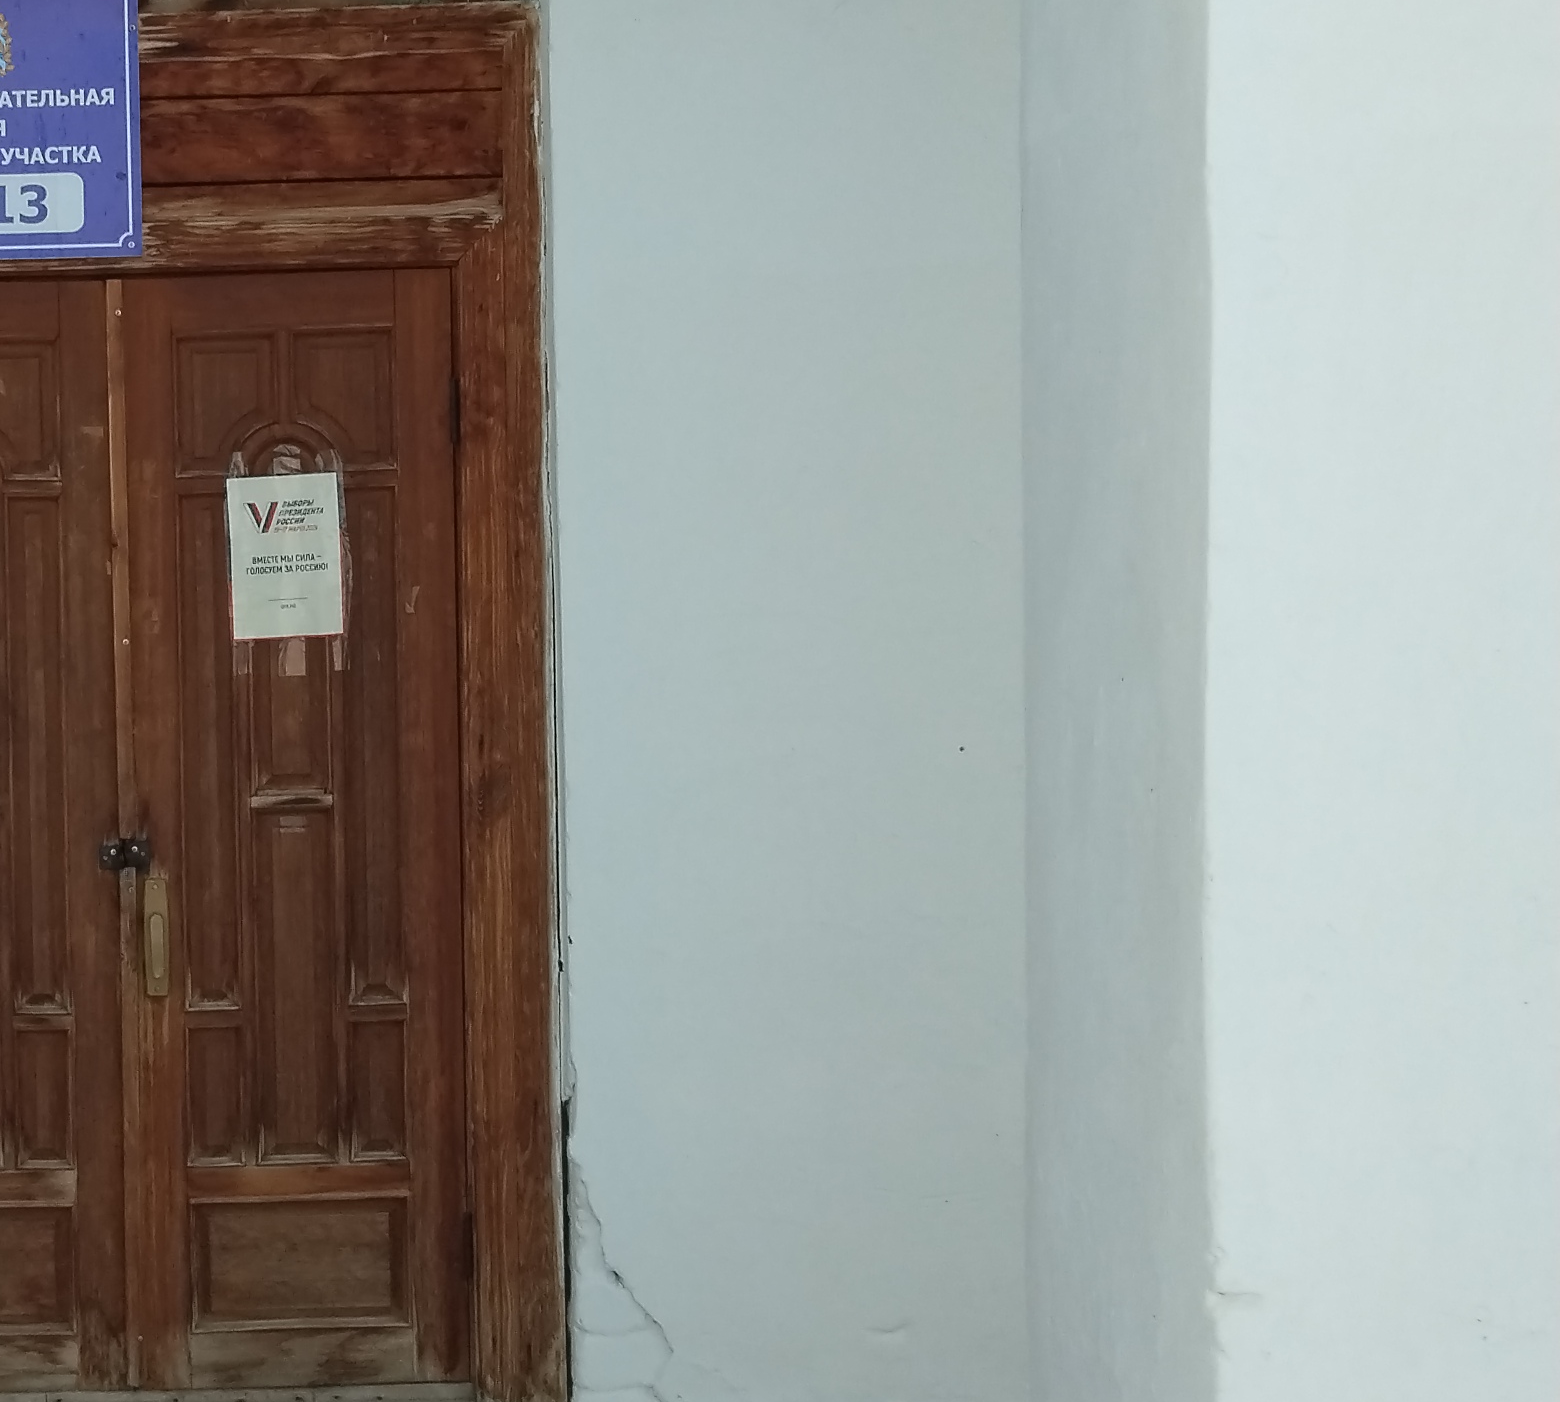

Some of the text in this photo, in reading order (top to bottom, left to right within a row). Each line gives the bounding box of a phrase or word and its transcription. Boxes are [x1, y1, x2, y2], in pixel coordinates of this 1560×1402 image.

[1, 145, 102, 167] УЧАСТКА
[282, 499, 314, 508] ВЫБОРЫ
[278, 507, 324, 517] ПРЕЗИДЕНТА
[276, 517, 305, 526] РОССИИ
[252, 556, 278, 565] ВМЕСТЕ
[280, 554, 293, 563] МЫ
[295, 553, 315, 562] СИЛА
[246, 566, 282, 575] ГОЛОСУЕМ
[284, 565, 293, 573] ЗА
